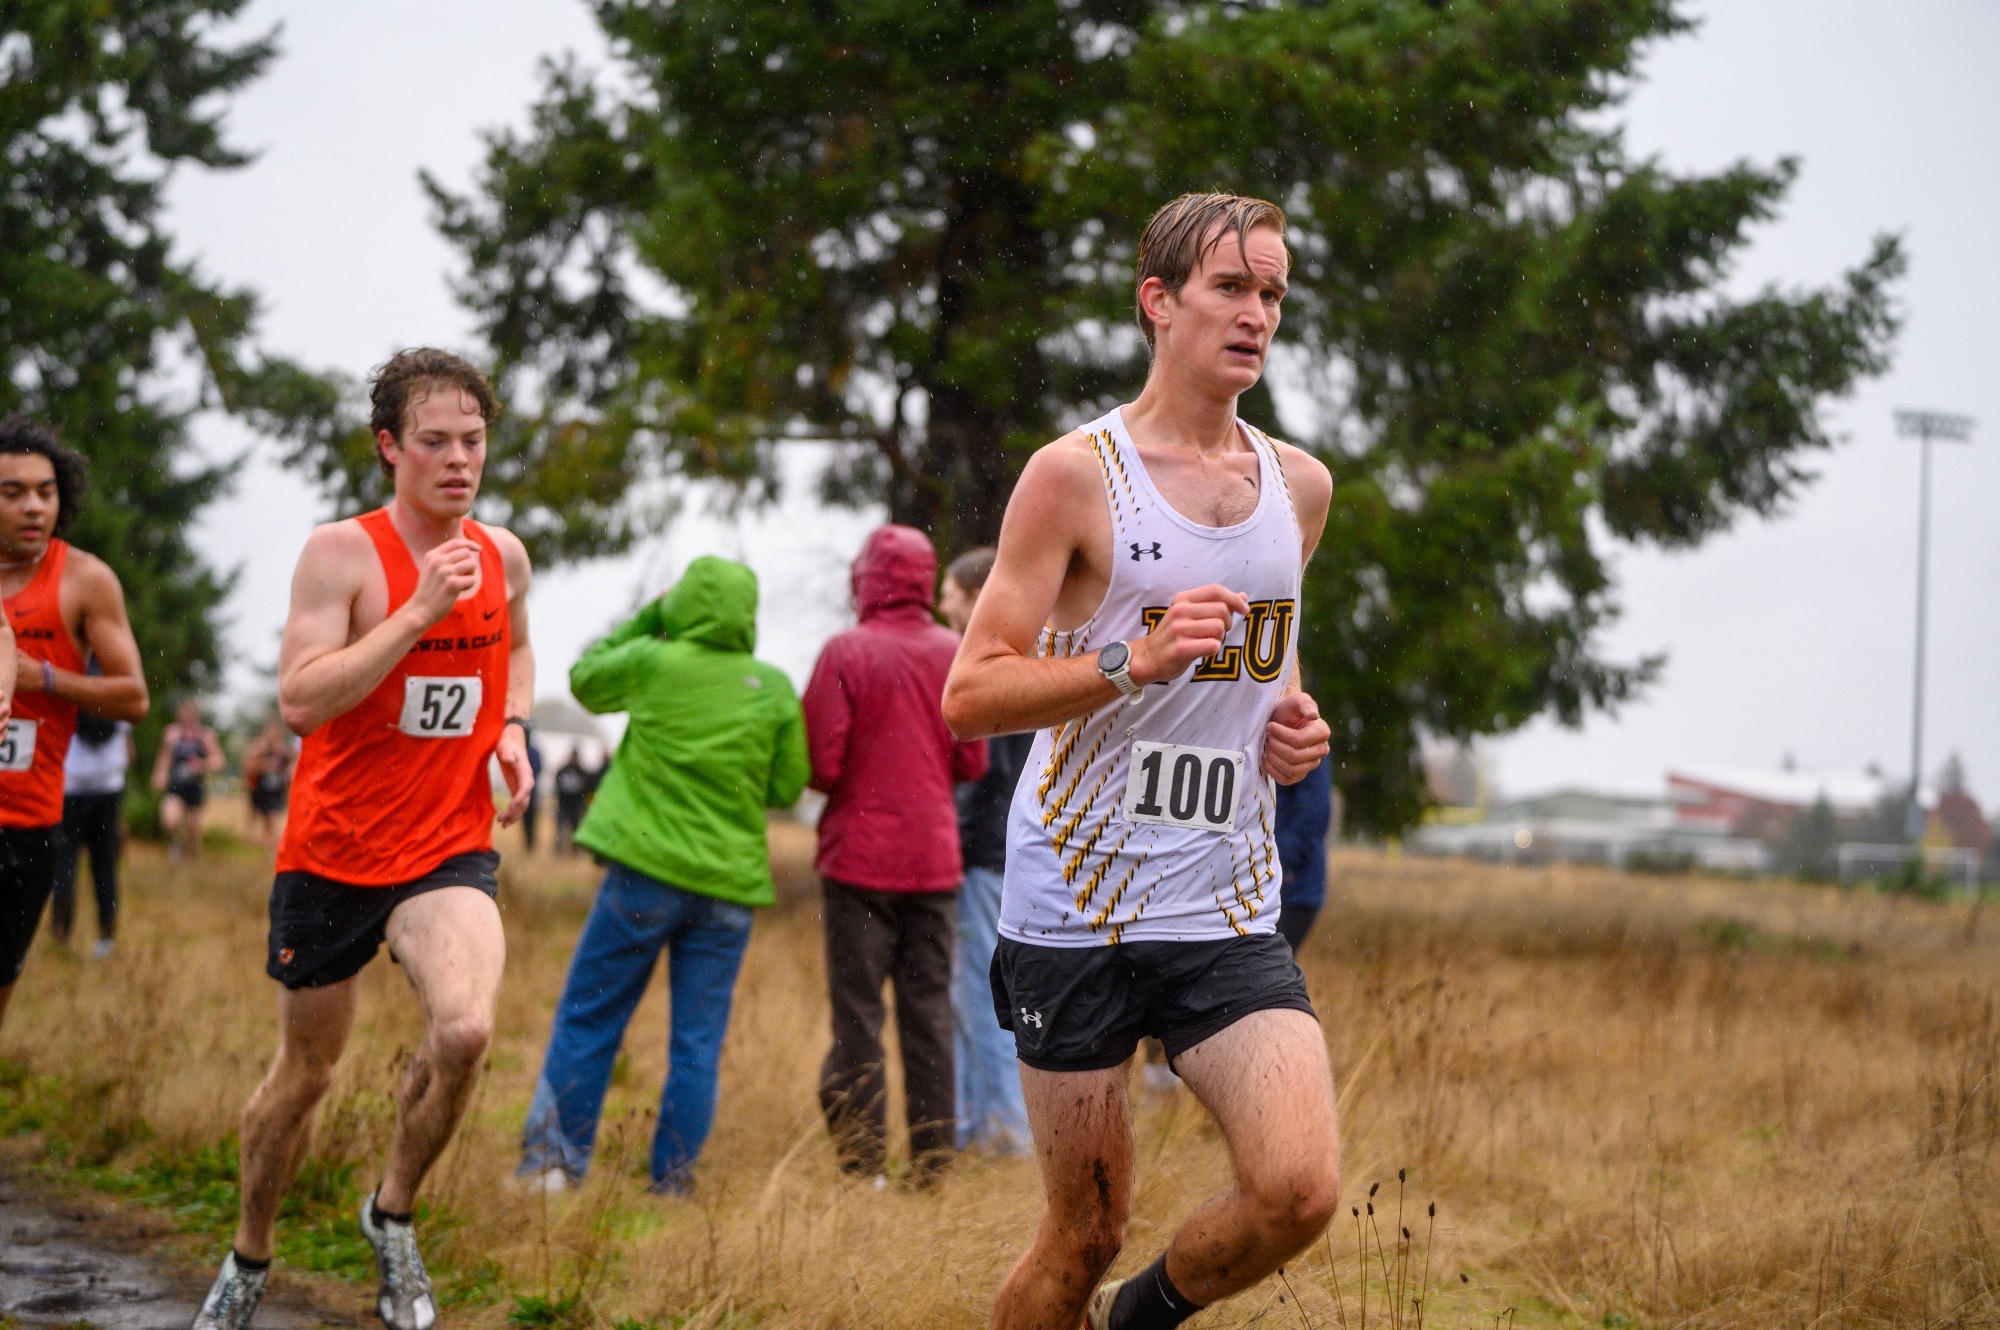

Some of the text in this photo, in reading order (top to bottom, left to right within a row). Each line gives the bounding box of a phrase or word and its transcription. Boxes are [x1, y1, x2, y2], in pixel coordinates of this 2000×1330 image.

[410, 638, 453, 652] WIS
[457, 637, 468, 650] &
[1142, 599, 1295, 684] LU
[420, 684, 467, 731] 52
[1134, 751, 1235, 824] 100
